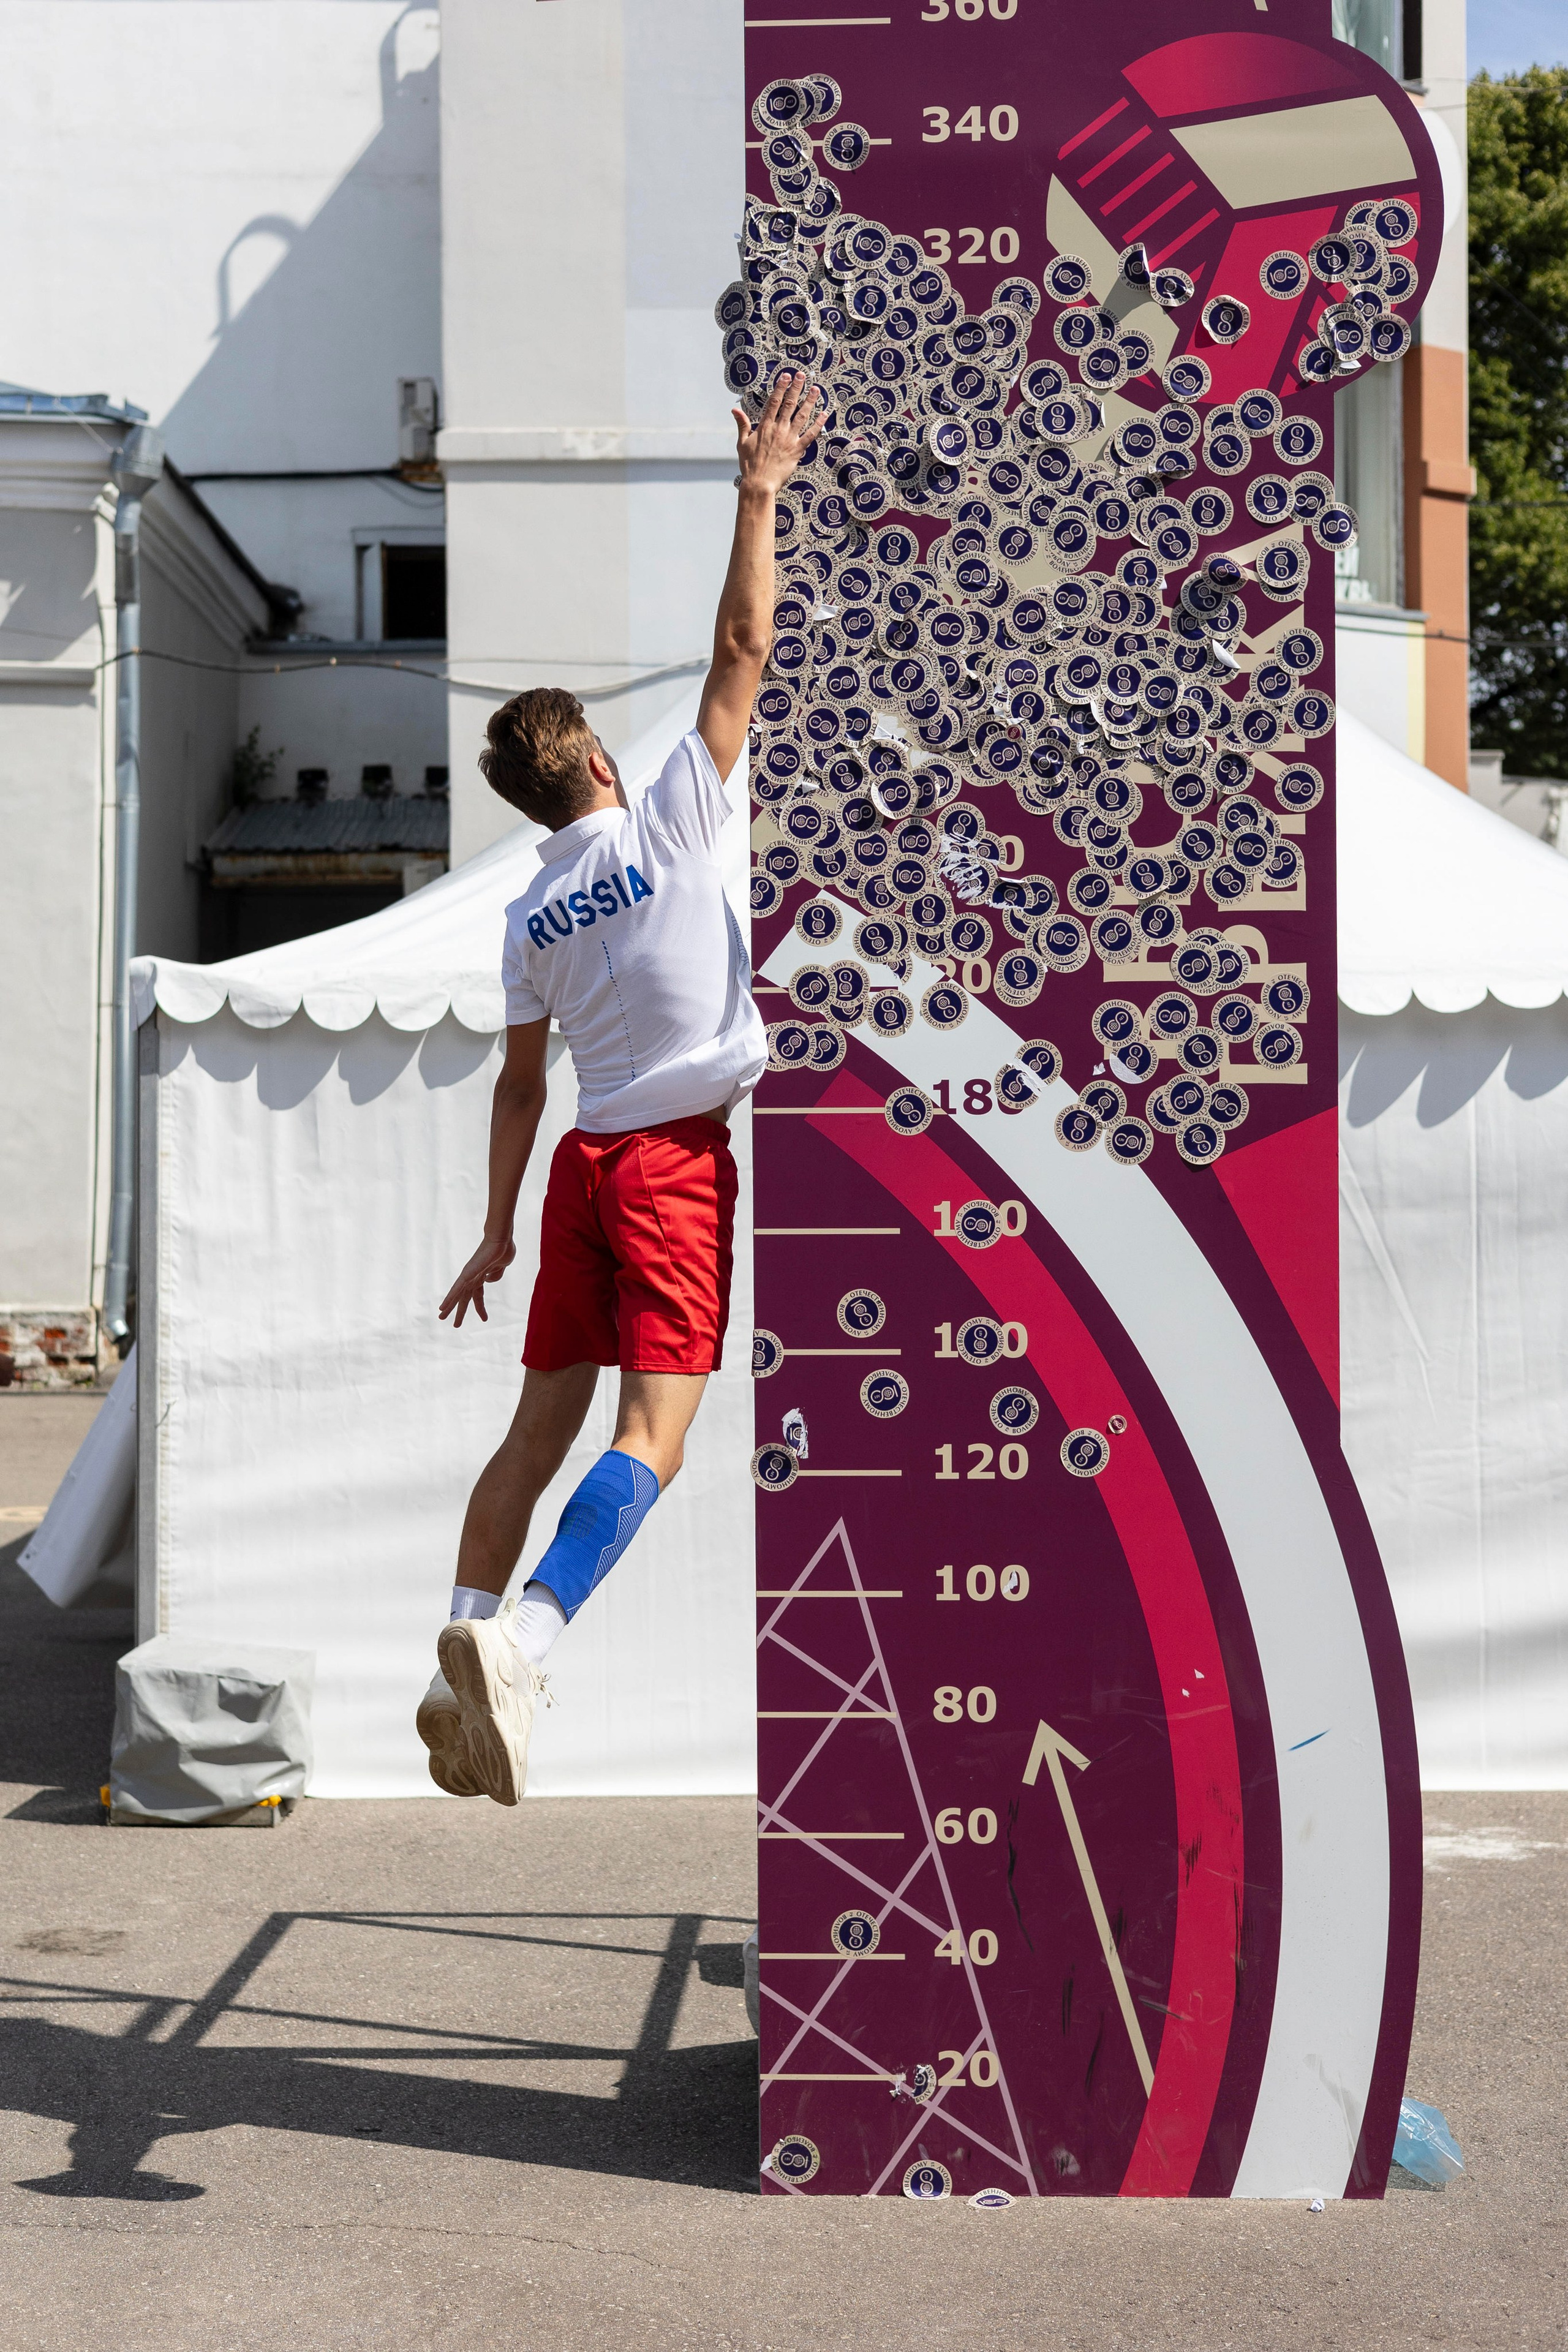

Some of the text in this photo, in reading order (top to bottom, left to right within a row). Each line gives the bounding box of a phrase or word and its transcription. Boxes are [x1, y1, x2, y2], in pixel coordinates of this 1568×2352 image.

[921, 0, 1018, 22] 360
[922, 104, 1019, 143] 340
[848, 222, 892, 252] ОТЕЧЕСТВЕННОМУ
[924, 226, 1020, 265] 320
[1048, 255, 1092, 290] ОТЕЧЕСТВЕННОМУ
[1261, 252, 1306, 283] ОТЕЧЕСТВЕННОМУ
[1116, 417, 1162, 446] ОТЕЧЕСТВЕННОМУ
[1275, 417, 1300, 463] ОТЕЧЕСТВЕННОМУ
[985, 454, 1028, 490] ОТЕЧЕСТВЕННОМУ
[1047, 512, 1089, 551] ОТЕЧЕСТВЕННОМУ
[831, 571, 875, 608] ОТЕЧЕСТВЕННОМУ
[1245, 709, 1283, 750] ОТЕЧЕСТВЕННОМУ
[782, 799, 828, 826] ОТЕЧЕСТВЕННОМУ
[1089, 771, 1116, 818] ОТЕЧЕСТВЕННОМУ
[1218, 521, 1309, 1084] ПРКА
[886, 854, 932, 880] ОТЕЧЕСТВЕННОМУ
[527, 864, 655, 951] RUSSIA
[1134, 899, 1168, 943] ОТЕЧЕСТВЕННОМУ
[931, 957, 992, 994] 20
[997, 950, 1025, 996] ОТЕЧЕСТВЕННОМУ
[794, 973, 836, 1012] ОТЕЧЕСТВЕННОМУ
[1278, 974, 1310, 1019] ОТЕЧЕСТВЕННОМУ
[894, 1088, 932, 1128] ОТЕЧЕСТВЕННОМУ
[933, 1079, 1023, 1115] 18
[933, 1199, 1028, 1237] 10
[955, 1219, 1001, 1248] ОТЕЧЕСТВЕННОМУ
[934, 1322, 1028, 1359] 10
[957, 1318, 982, 1365] ОТЕЧЕСТВЕННОМУ
[863, 1387, 907, 1417] ОТЕЧЕСТВЕННОМУ
[935, 1442, 1029, 1480] 120
[1072, 1433, 1108, 1476] ОТЕЧЕСТВЕННОМУ
[936, 1564, 1030, 1602] 100
[933, 1686, 997, 1723] 80
[935, 1807, 998, 1844] 60
[853, 1912, 879, 1957] ОТЕЧЕСТВЕННОМУ
[934, 1929, 998, 1966] 40
[938, 2050, 1000, 2087] 20
